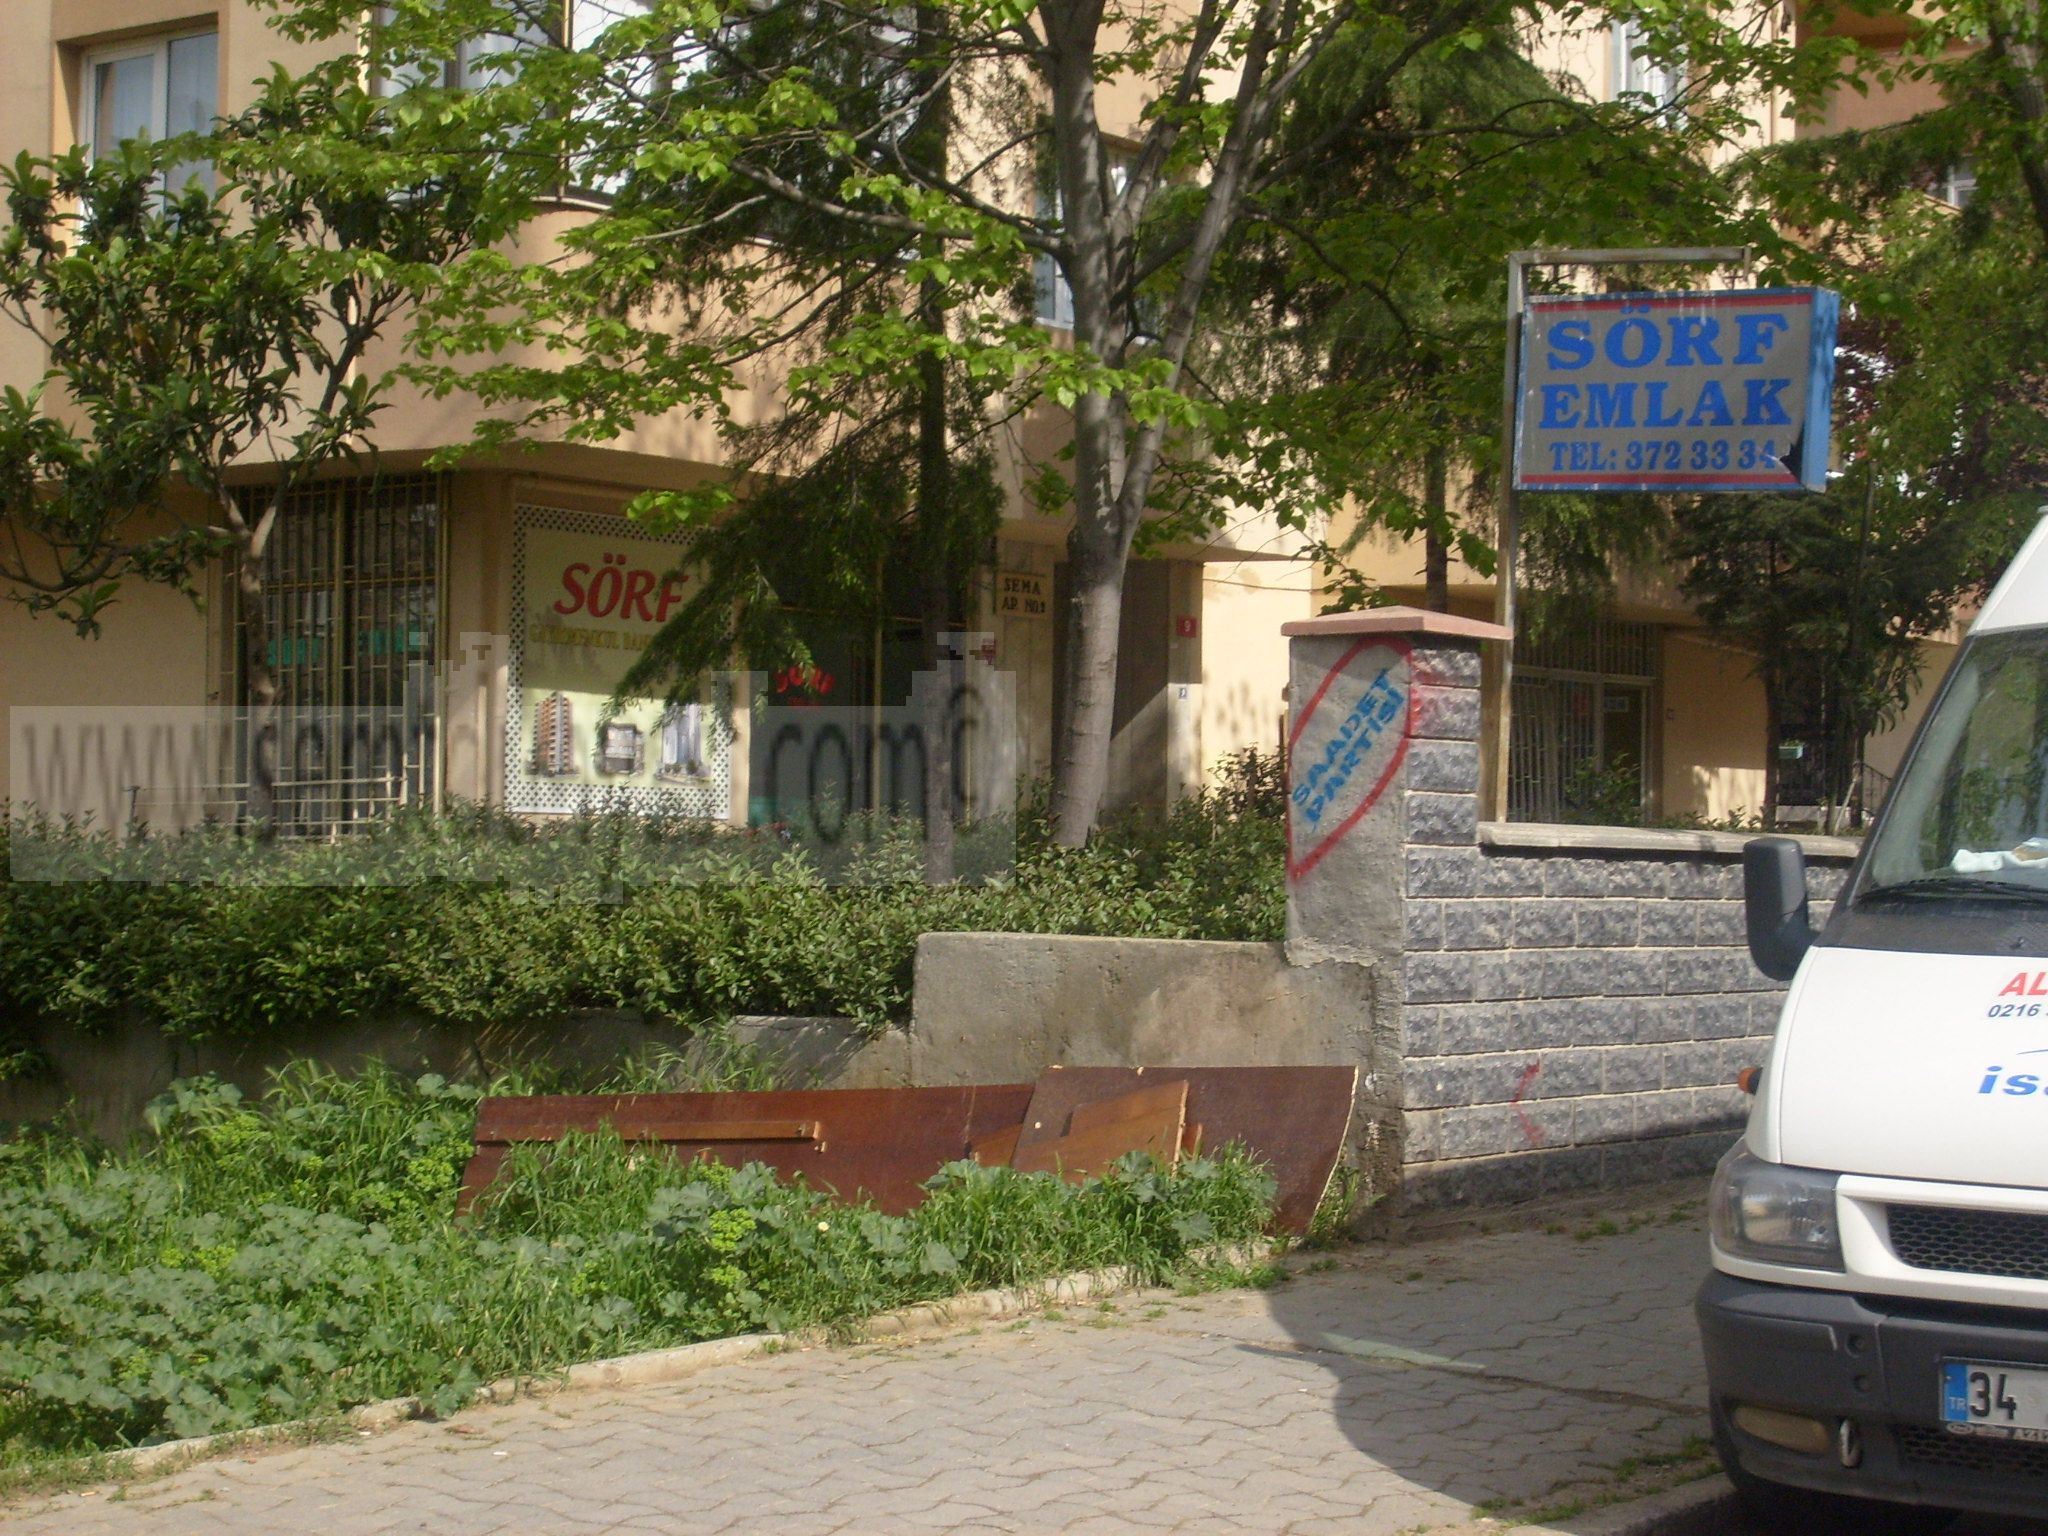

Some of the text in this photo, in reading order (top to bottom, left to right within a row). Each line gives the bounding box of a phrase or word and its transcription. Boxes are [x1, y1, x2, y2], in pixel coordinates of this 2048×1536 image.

[1547, 304, 1789, 371] SÖRF
[1539, 378, 1793, 429] EMLAK
[1551, 441, 1617, 472] TEL:
[1626, 440, 1682, 471] 372
[1690, 439, 1730, 470] 33
[553, 552, 690, 623] SÖRF
[1292, 667, 1392, 807] SAADET
[1988, 1003, 2042, 1019] 0216
[1948, 1371, 2017, 1420] TR 34
